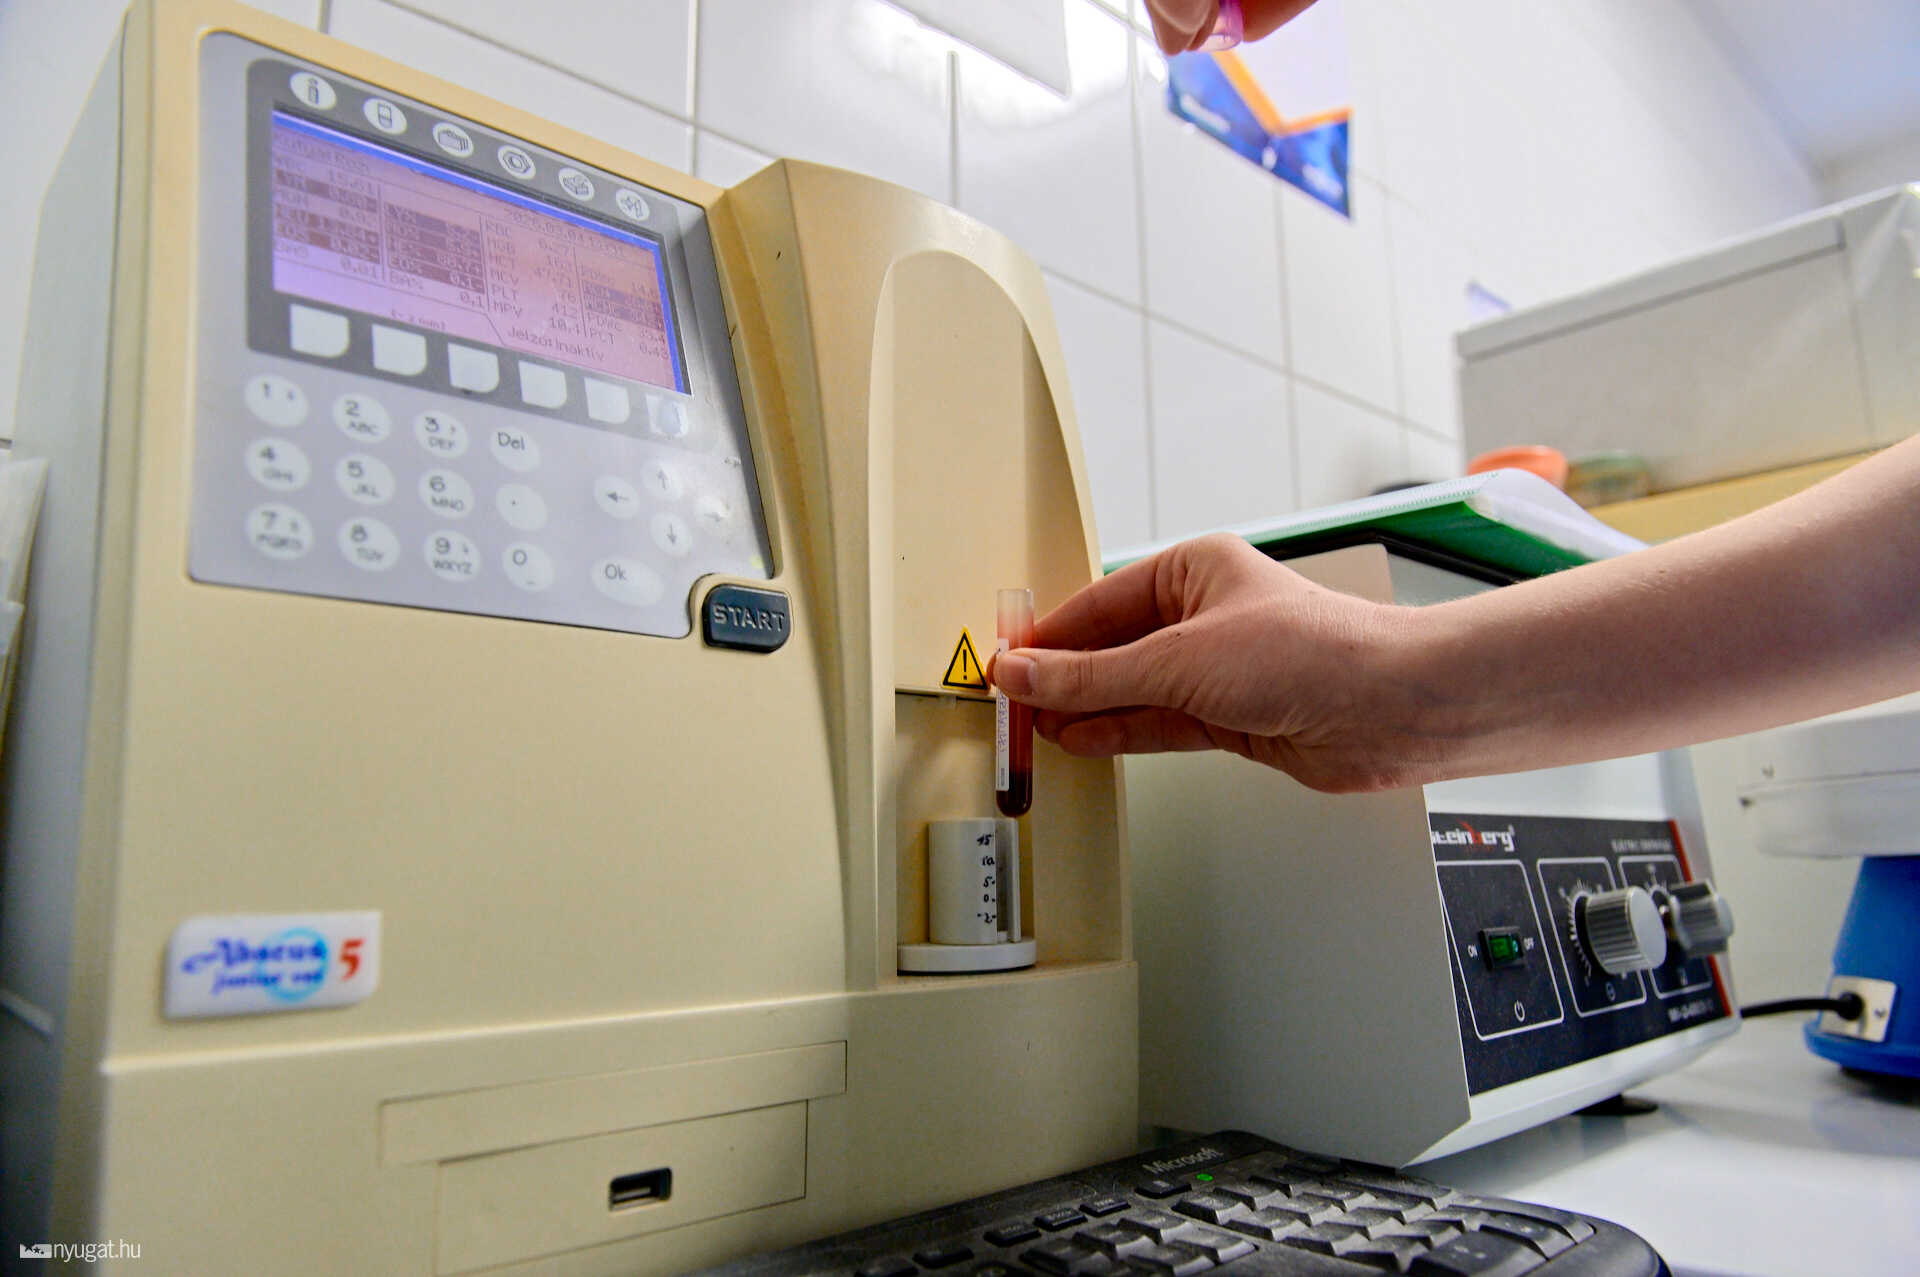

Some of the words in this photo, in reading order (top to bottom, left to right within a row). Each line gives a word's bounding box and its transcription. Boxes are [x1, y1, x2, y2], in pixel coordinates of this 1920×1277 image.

[345, 399, 361, 417] 2
[424, 415, 440, 433] 3
[496, 430, 526, 451] Del
[346, 459, 365, 478] 5
[428, 475, 447, 493] 6
[349, 523, 369, 543] 8
[434, 535, 452, 556] 9
[603, 562, 628, 582] Ok
[711, 602, 786, 633] START
